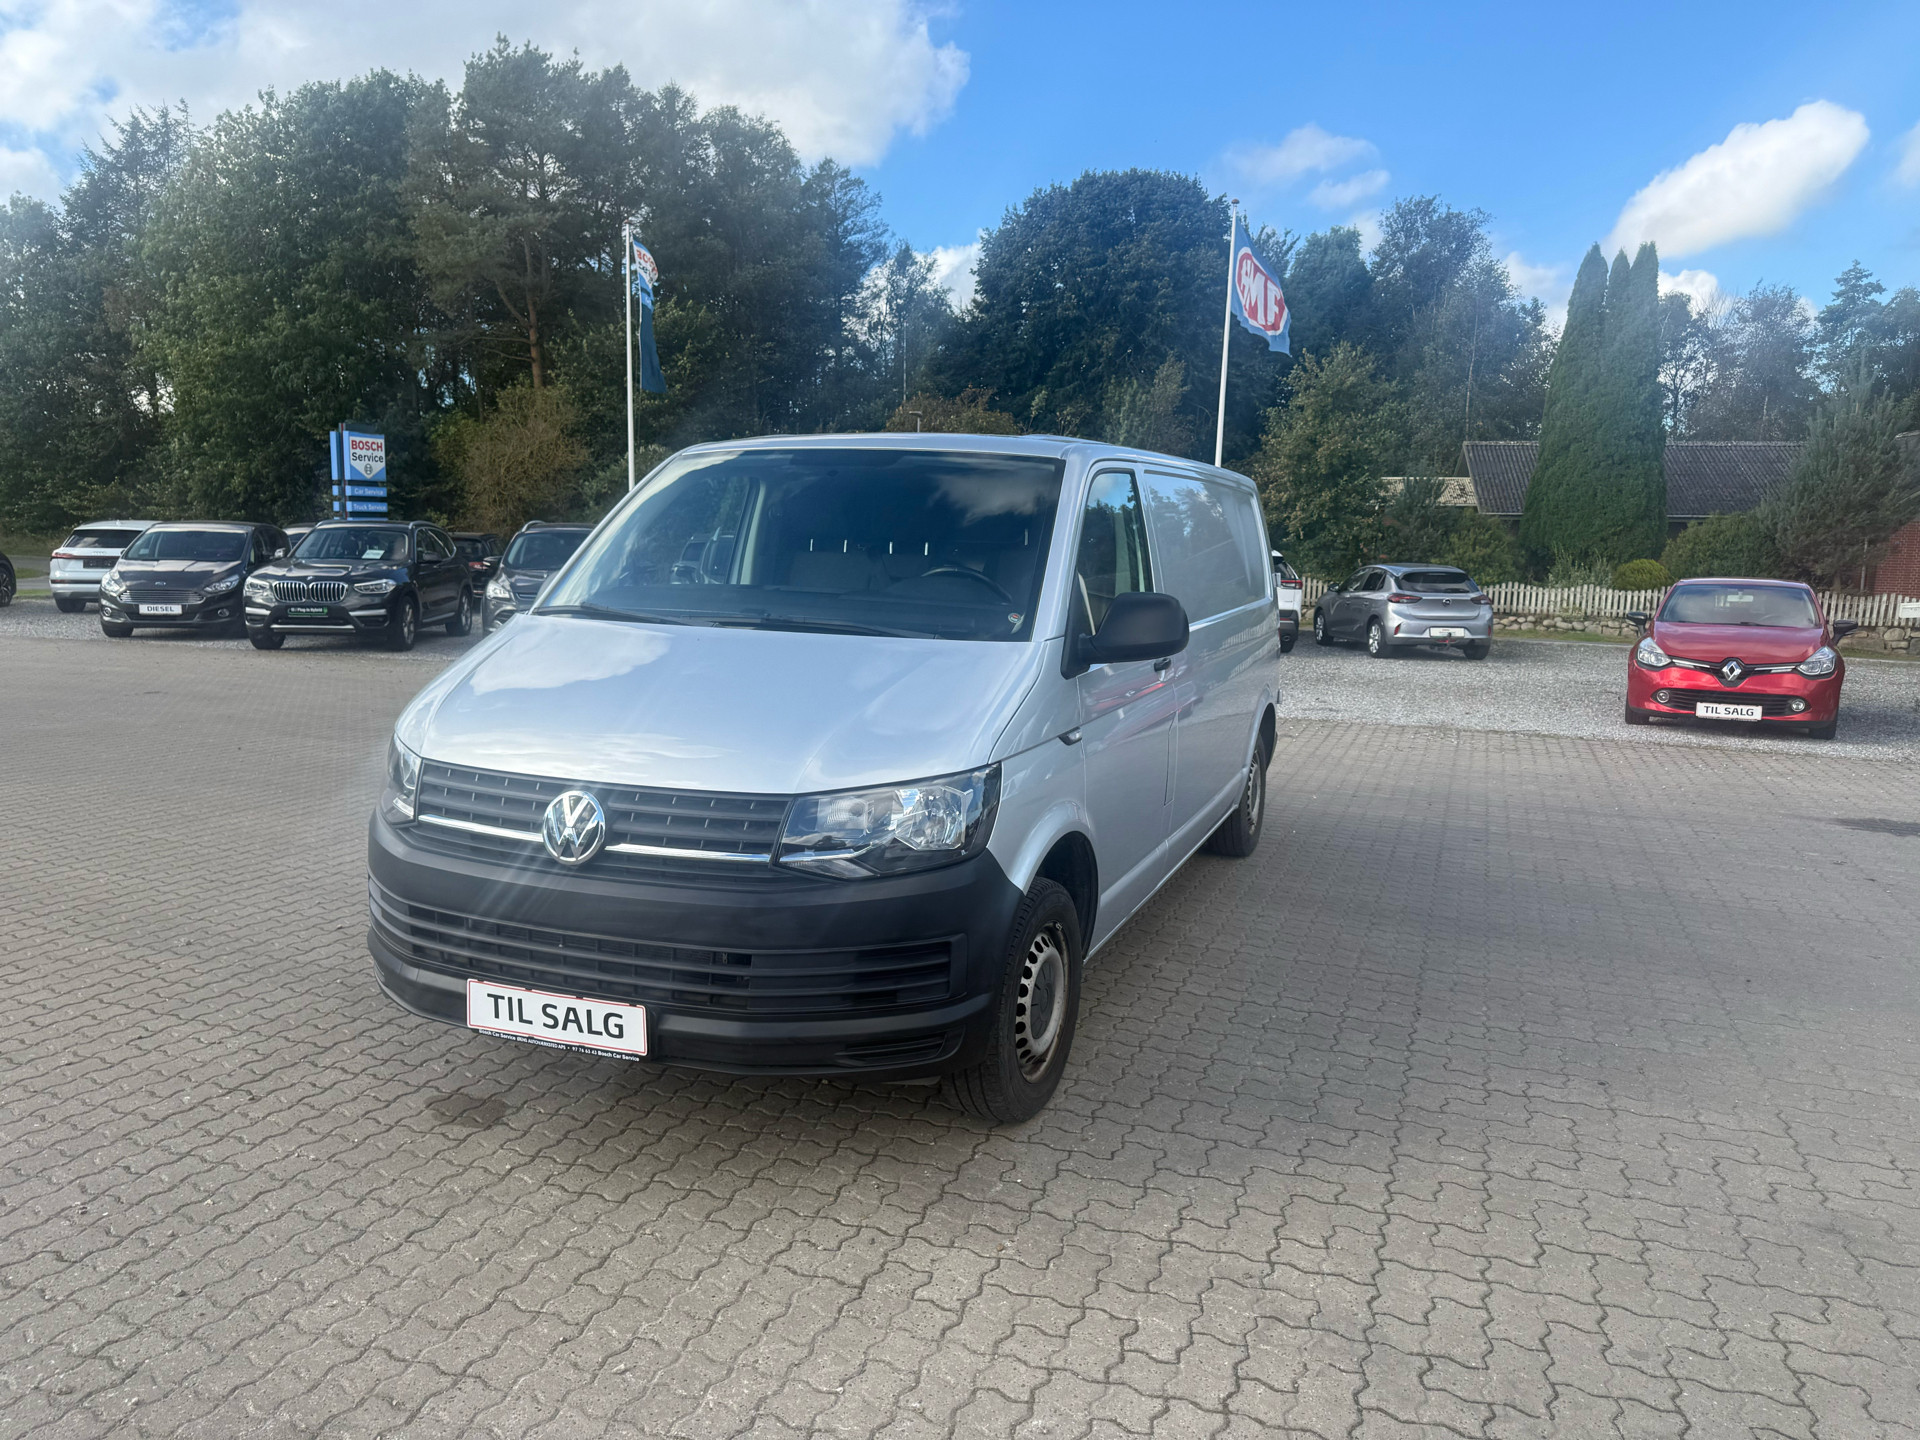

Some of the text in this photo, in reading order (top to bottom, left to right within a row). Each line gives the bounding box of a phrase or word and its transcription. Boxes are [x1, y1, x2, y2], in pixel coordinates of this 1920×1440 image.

[1240, 259, 1281, 325] AMF
[351, 440, 383, 452] BOSCH
[352, 452, 384, 463] Service
[365, 488, 383, 496] Service
[1704, 706, 1754, 716] TIL SALG
[487, 993, 624, 1039] TIL SALG
